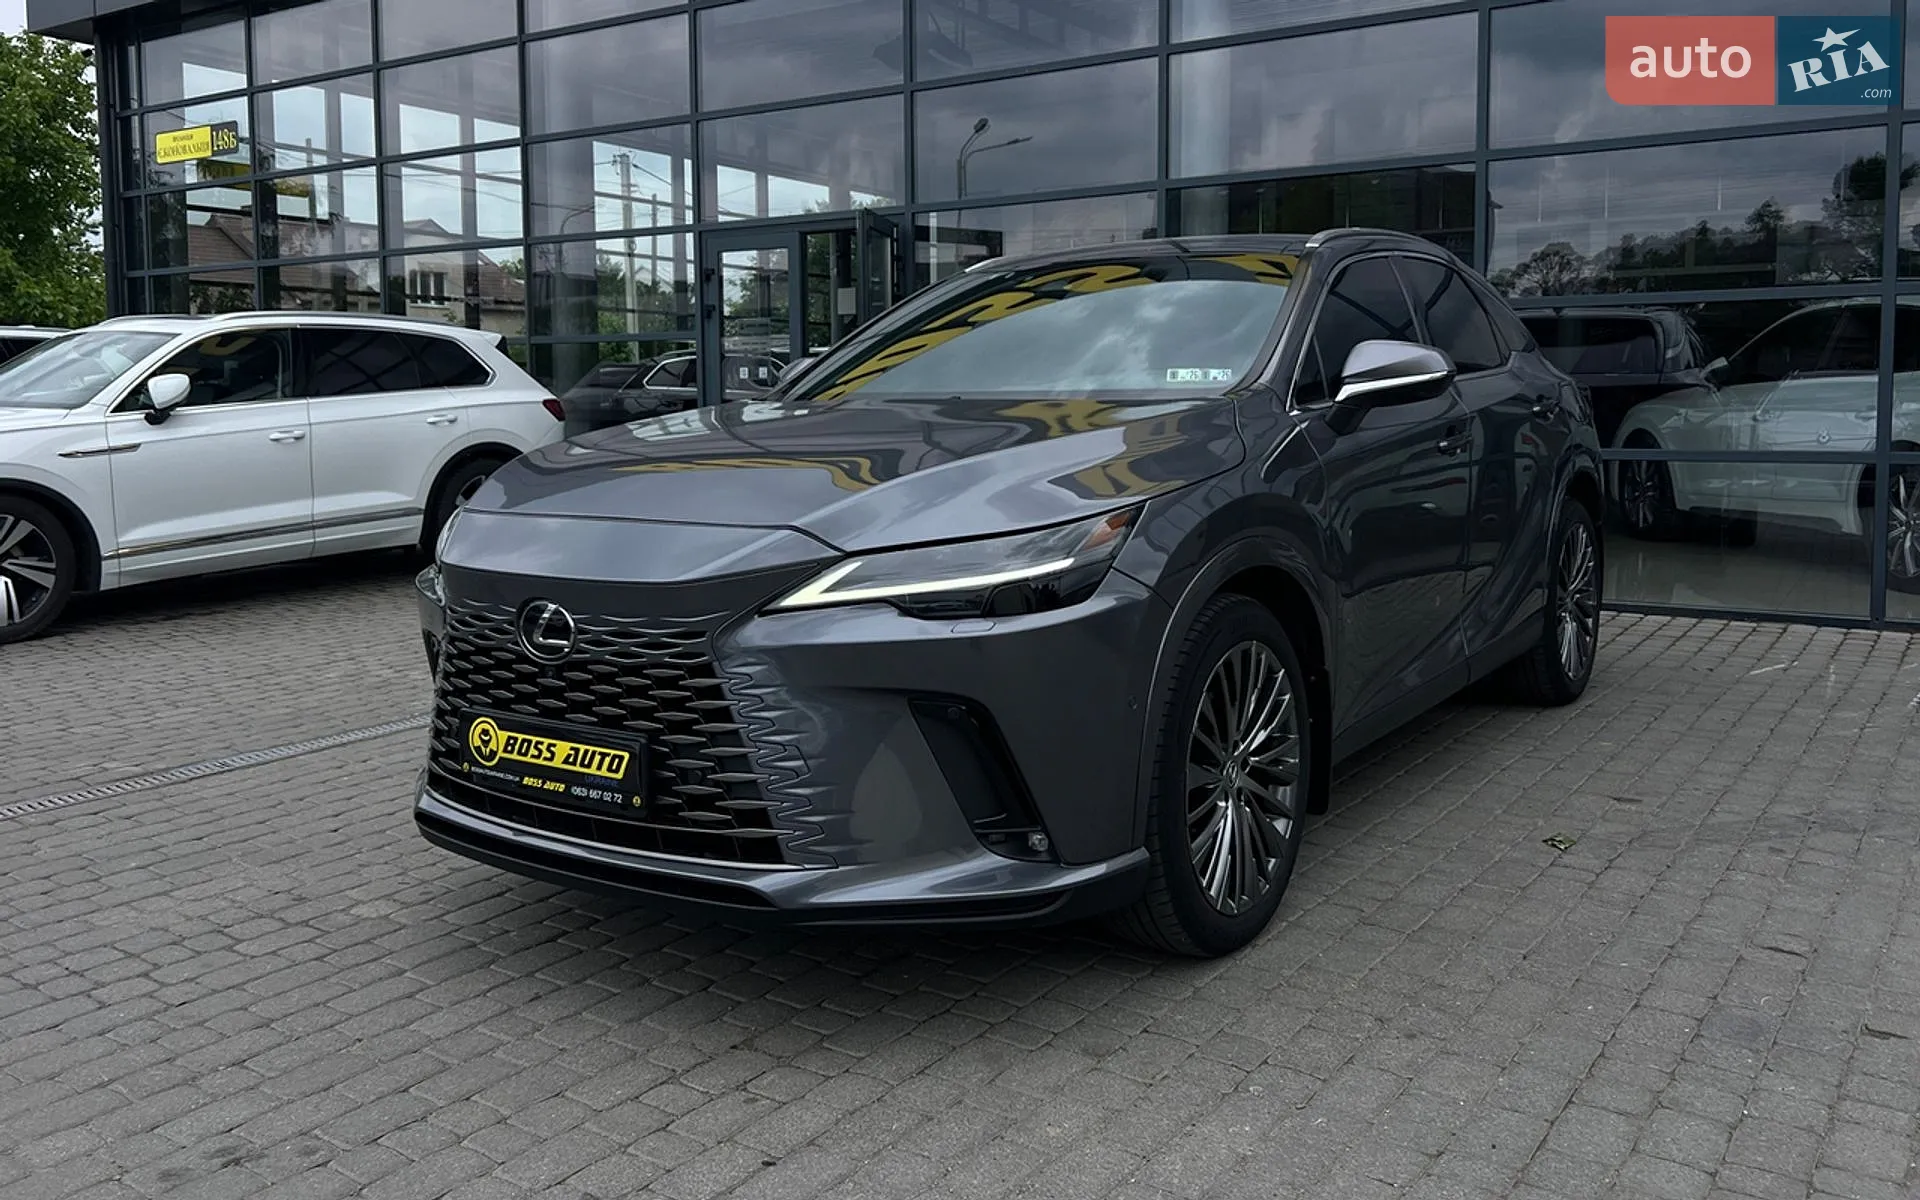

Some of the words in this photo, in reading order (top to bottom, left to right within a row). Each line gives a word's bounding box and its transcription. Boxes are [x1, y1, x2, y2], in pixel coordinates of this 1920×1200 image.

[212, 128, 237, 151] 148Б
[502, 735, 557, 762] BOSS
[562, 746, 625, 774] AUTO
[522, 776, 542, 788] BOSS
[543, 780, 565, 793] AUTO
[602, 792, 612, 801] 02
[613, 794, 623, 803] 72
